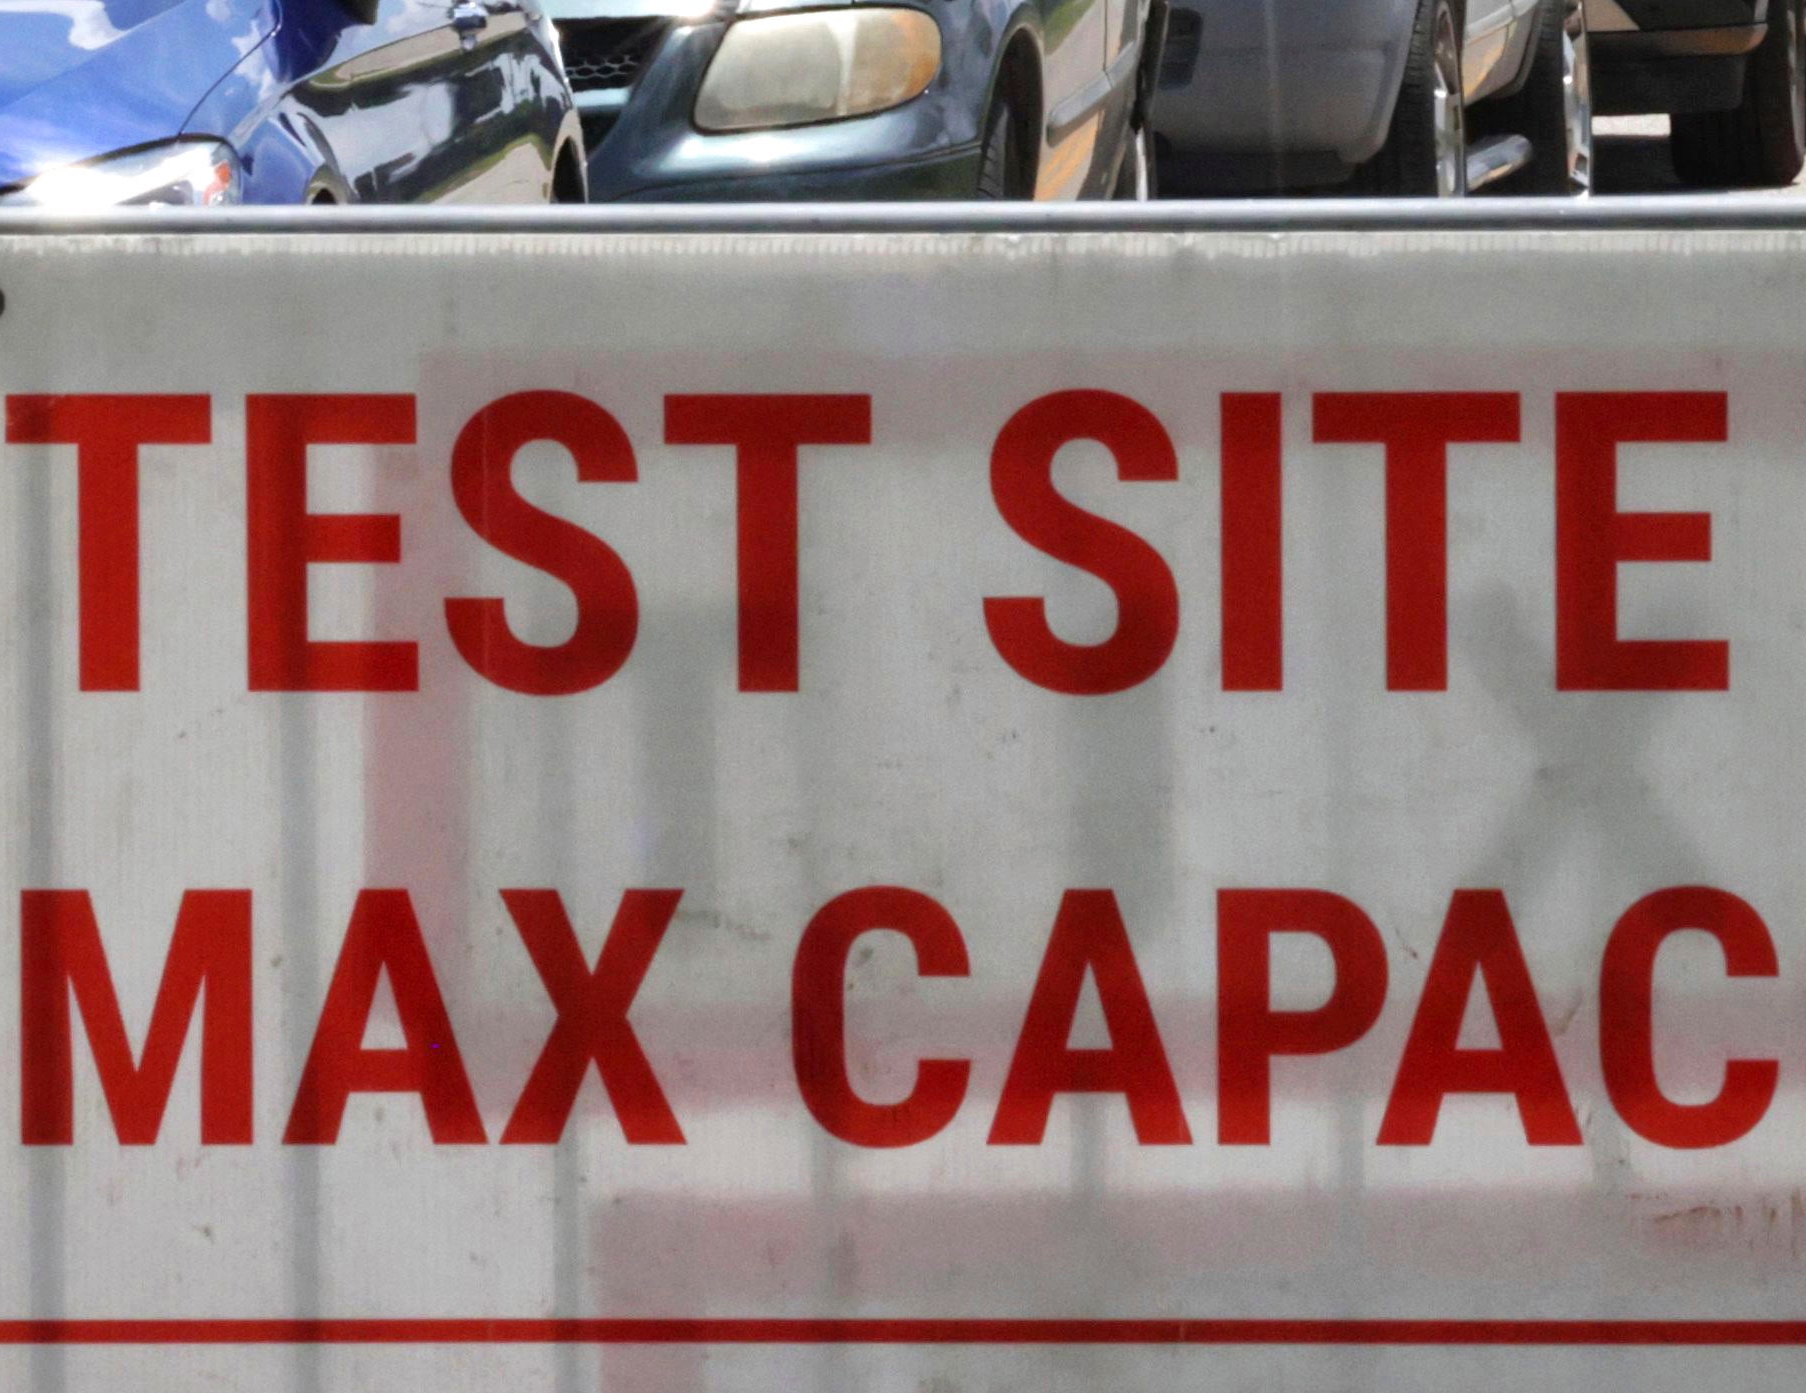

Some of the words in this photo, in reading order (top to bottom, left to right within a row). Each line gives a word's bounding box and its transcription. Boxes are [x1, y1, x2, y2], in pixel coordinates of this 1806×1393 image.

[7, 390, 871, 696] TEST
[985, 390, 1729, 695] SITE
[20, 888, 685, 1147] MAX
